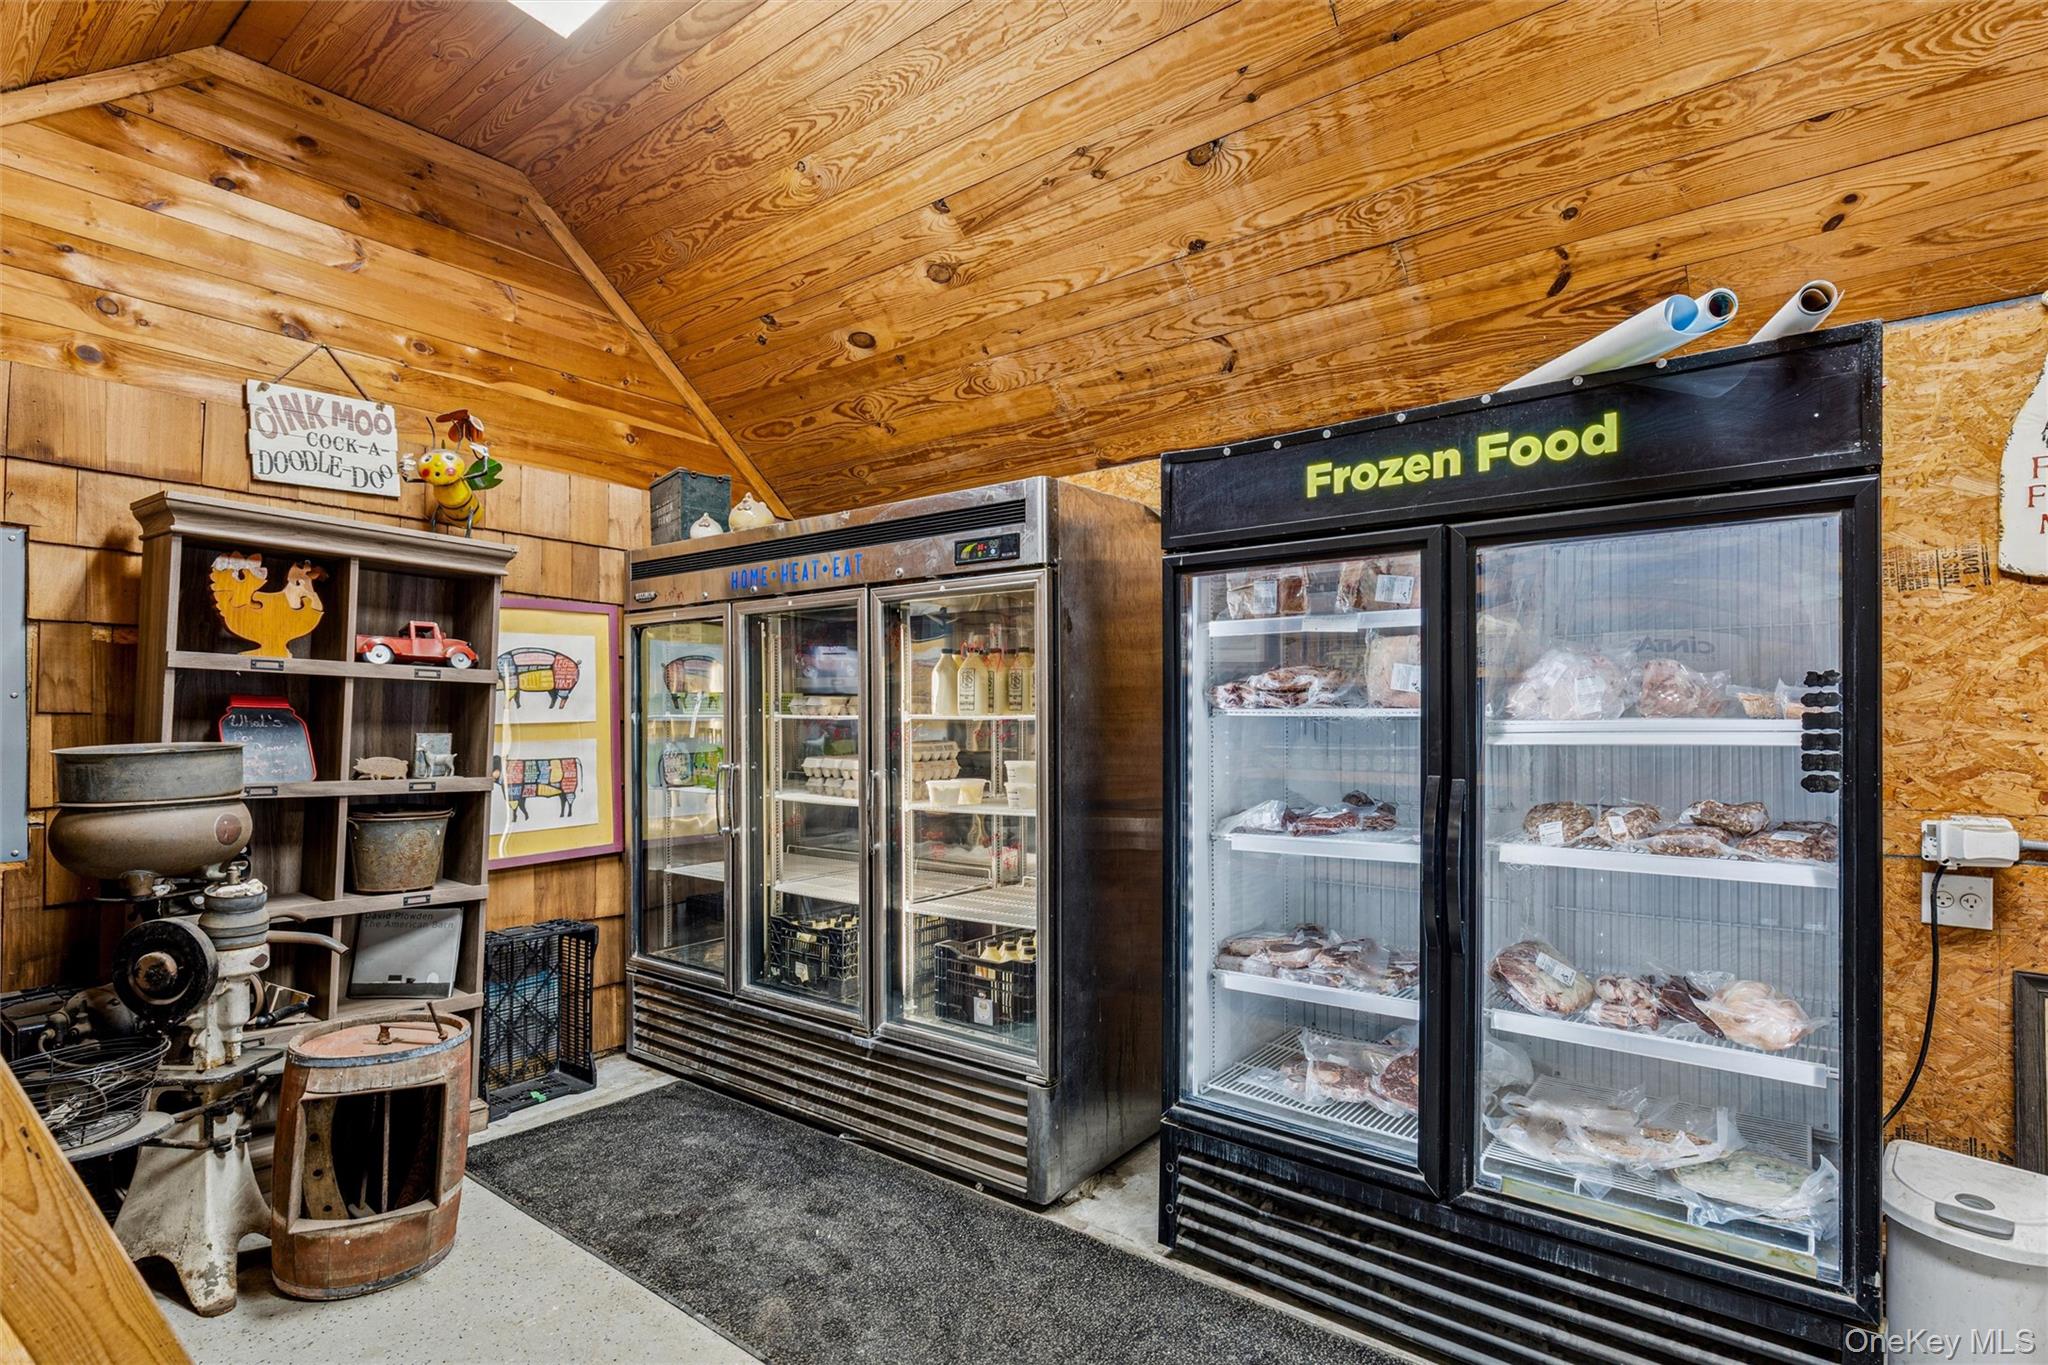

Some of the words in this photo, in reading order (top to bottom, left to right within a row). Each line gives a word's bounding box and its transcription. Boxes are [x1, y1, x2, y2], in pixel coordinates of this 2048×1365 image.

[254, 391, 328, 439] OINK
[332, 400, 392, 437] MOO
[306, 431, 390, 457] COCK-A-
[1306, 448, 1462, 498] Frozen
[1477, 411, 1618, 473] Food
[258, 449, 394, 489] DOODLE-DOO
[730, 564, 768, 590] HOME
[780, 559, 819, 584] HEAT
[833, 553, 864, 578] EAT
[364, 920, 382, 928] The
[384, 920, 430, 929] American
[432, 920, 454, 929] Barn
[365, 912, 392, 920] David
[395, 911, 433, 921] Plowden
